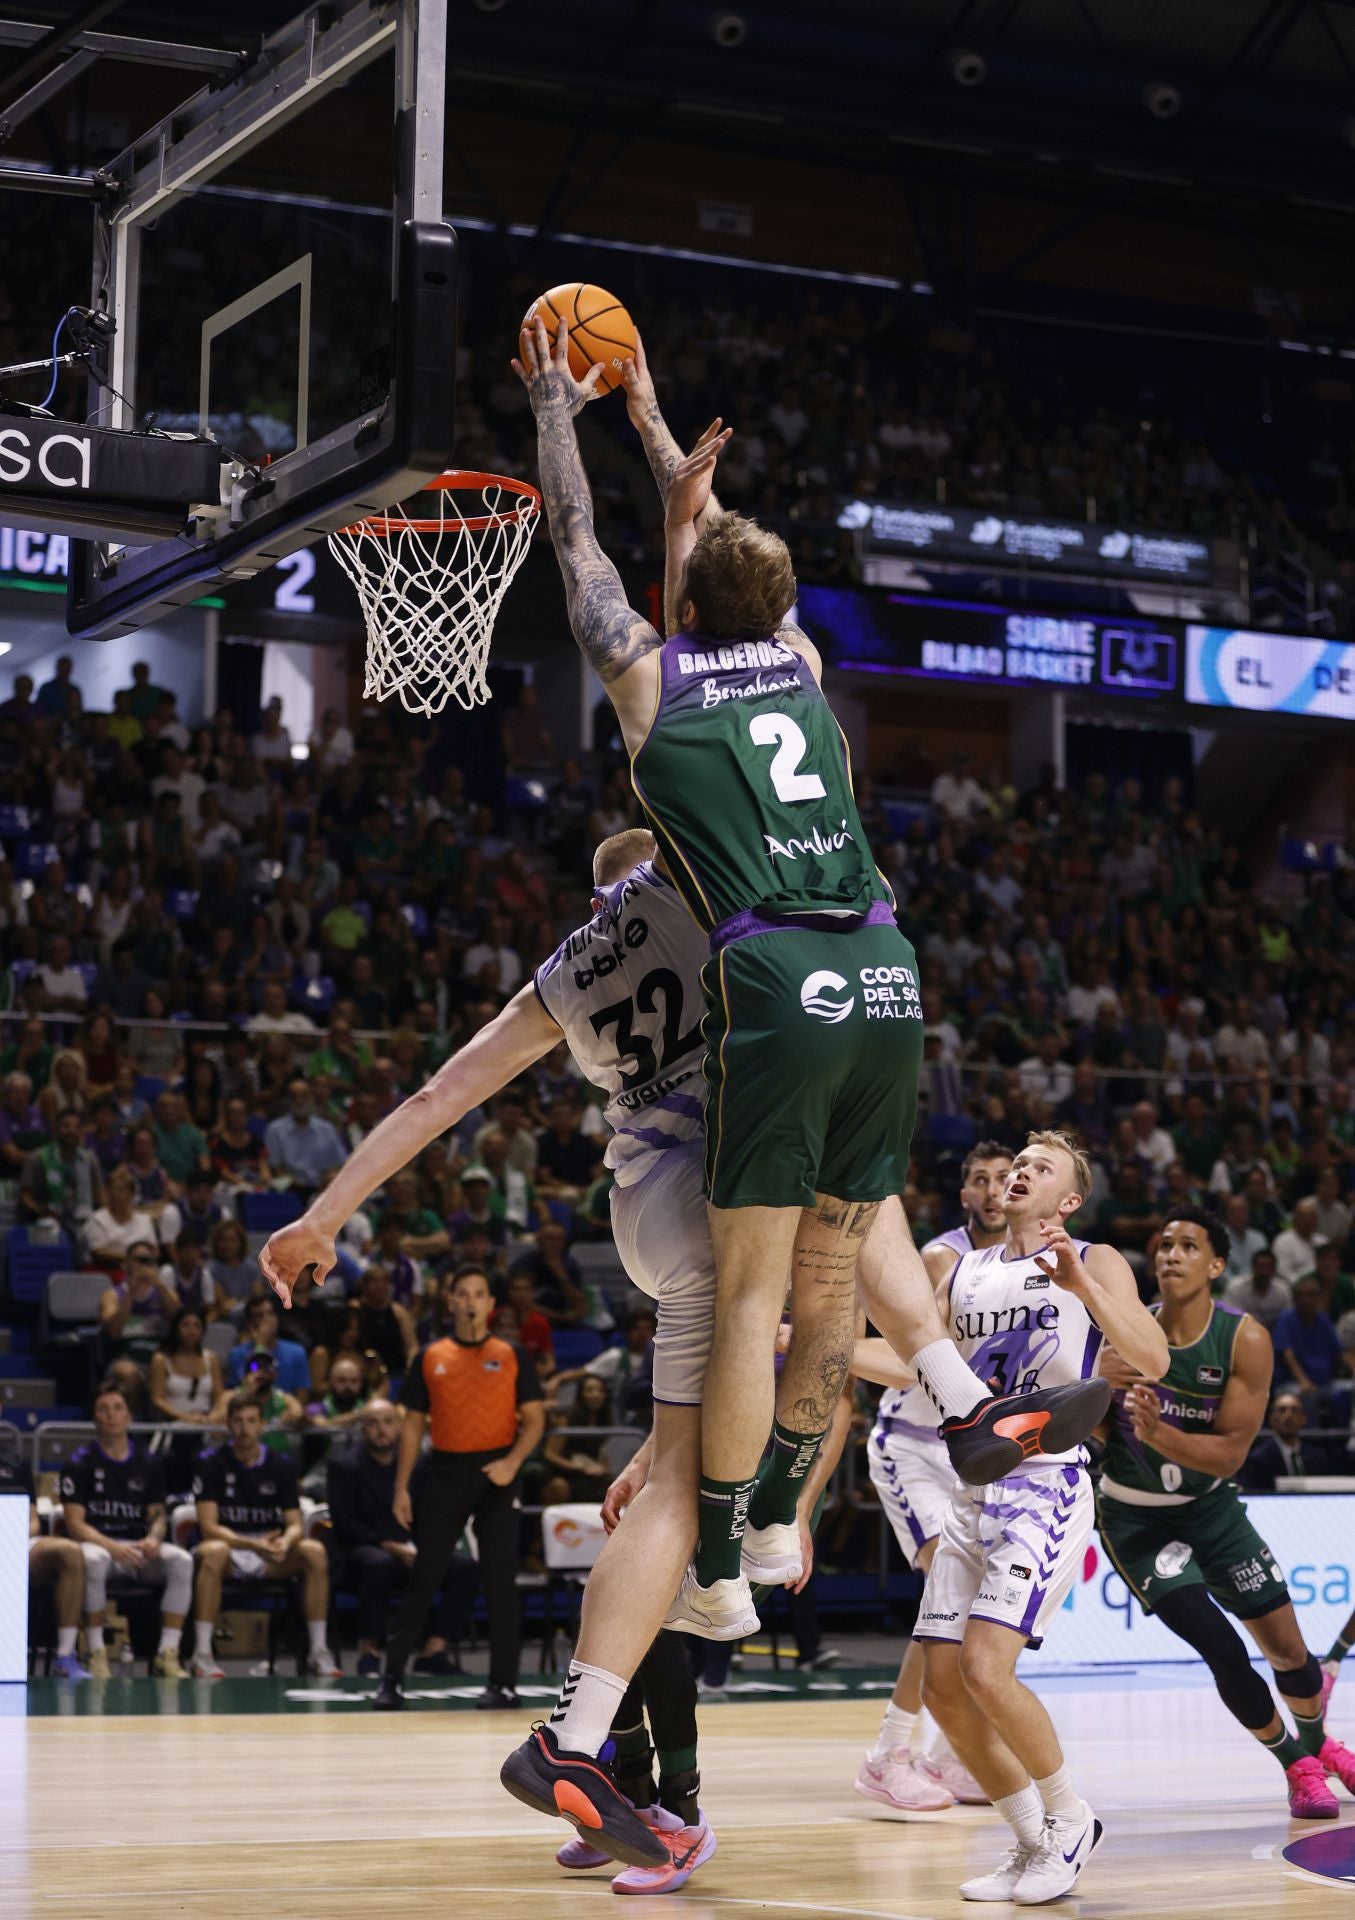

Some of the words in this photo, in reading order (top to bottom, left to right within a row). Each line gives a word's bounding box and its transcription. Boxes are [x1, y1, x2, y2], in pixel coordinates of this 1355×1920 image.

[274, 548, 316, 613] 2
[1005, 648, 1096, 685] BASKET
[1236, 655, 1273, 688] EL
[749, 712, 828, 803] 2
[863, 987, 902, 1003] DEL
[902, 986, 921, 1006] SO
[588, 966, 706, 1094] 32
[955, 1304, 1060, 1342] surne
[786, 1444, 818, 1479] UNICAJA
[1160, 1463, 1182, 1493] 0
[728, 1491, 751, 1540] UNICAJA
[1010, 1568, 1026, 1579] acb
